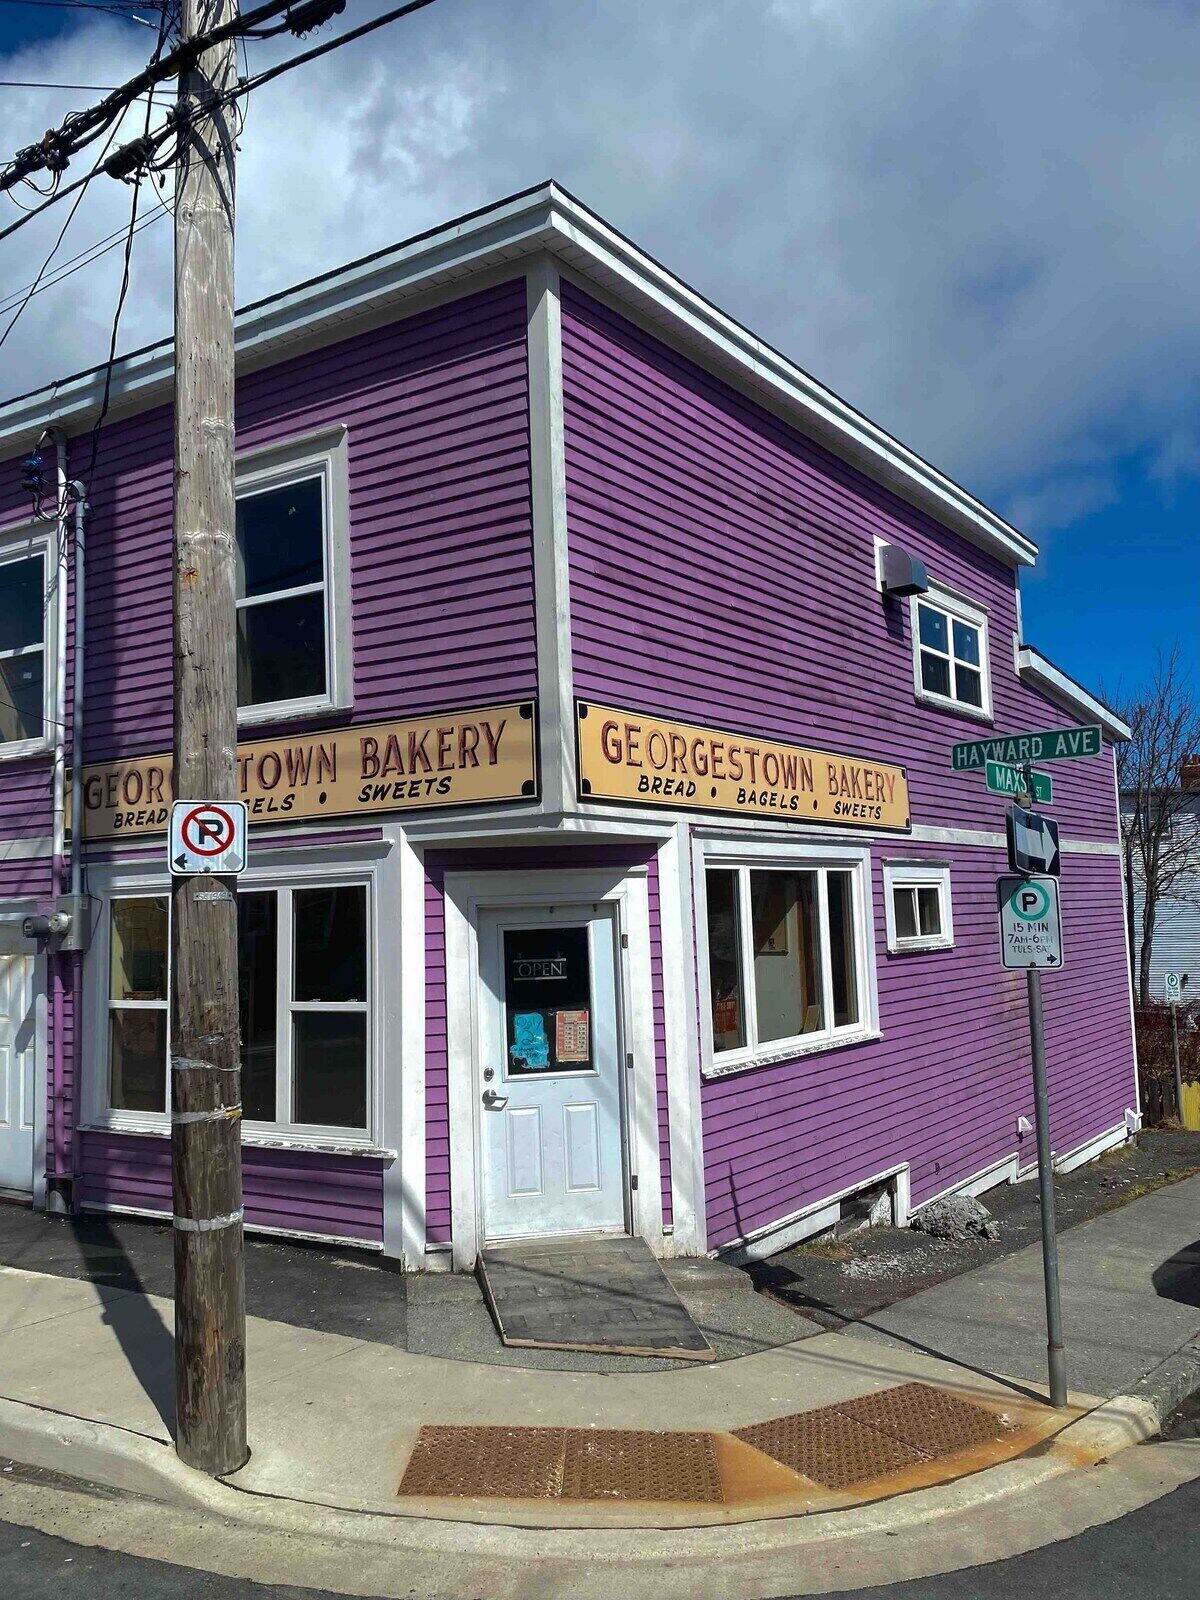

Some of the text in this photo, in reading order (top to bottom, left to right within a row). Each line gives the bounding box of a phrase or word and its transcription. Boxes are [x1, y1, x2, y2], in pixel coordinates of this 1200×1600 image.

[85, 719, 507, 811] GEORTOWN BAKERY
[600, 719, 896, 804] GEORGESTOWN BAKERY
[956, 731, 1095, 767] HAYWARD AVE
[637, 774, 882, 820] BREAD BAGELS SWEETS
[995, 766, 1043, 798] MAXS ST
[113, 808, 169, 829] BREAD
[357, 775, 453, 803] SWEETS
[1021, 892, 1038, 912] P
[1013, 922, 1050, 933] 15 MIN
[518, 962, 563, 977] OPEN
